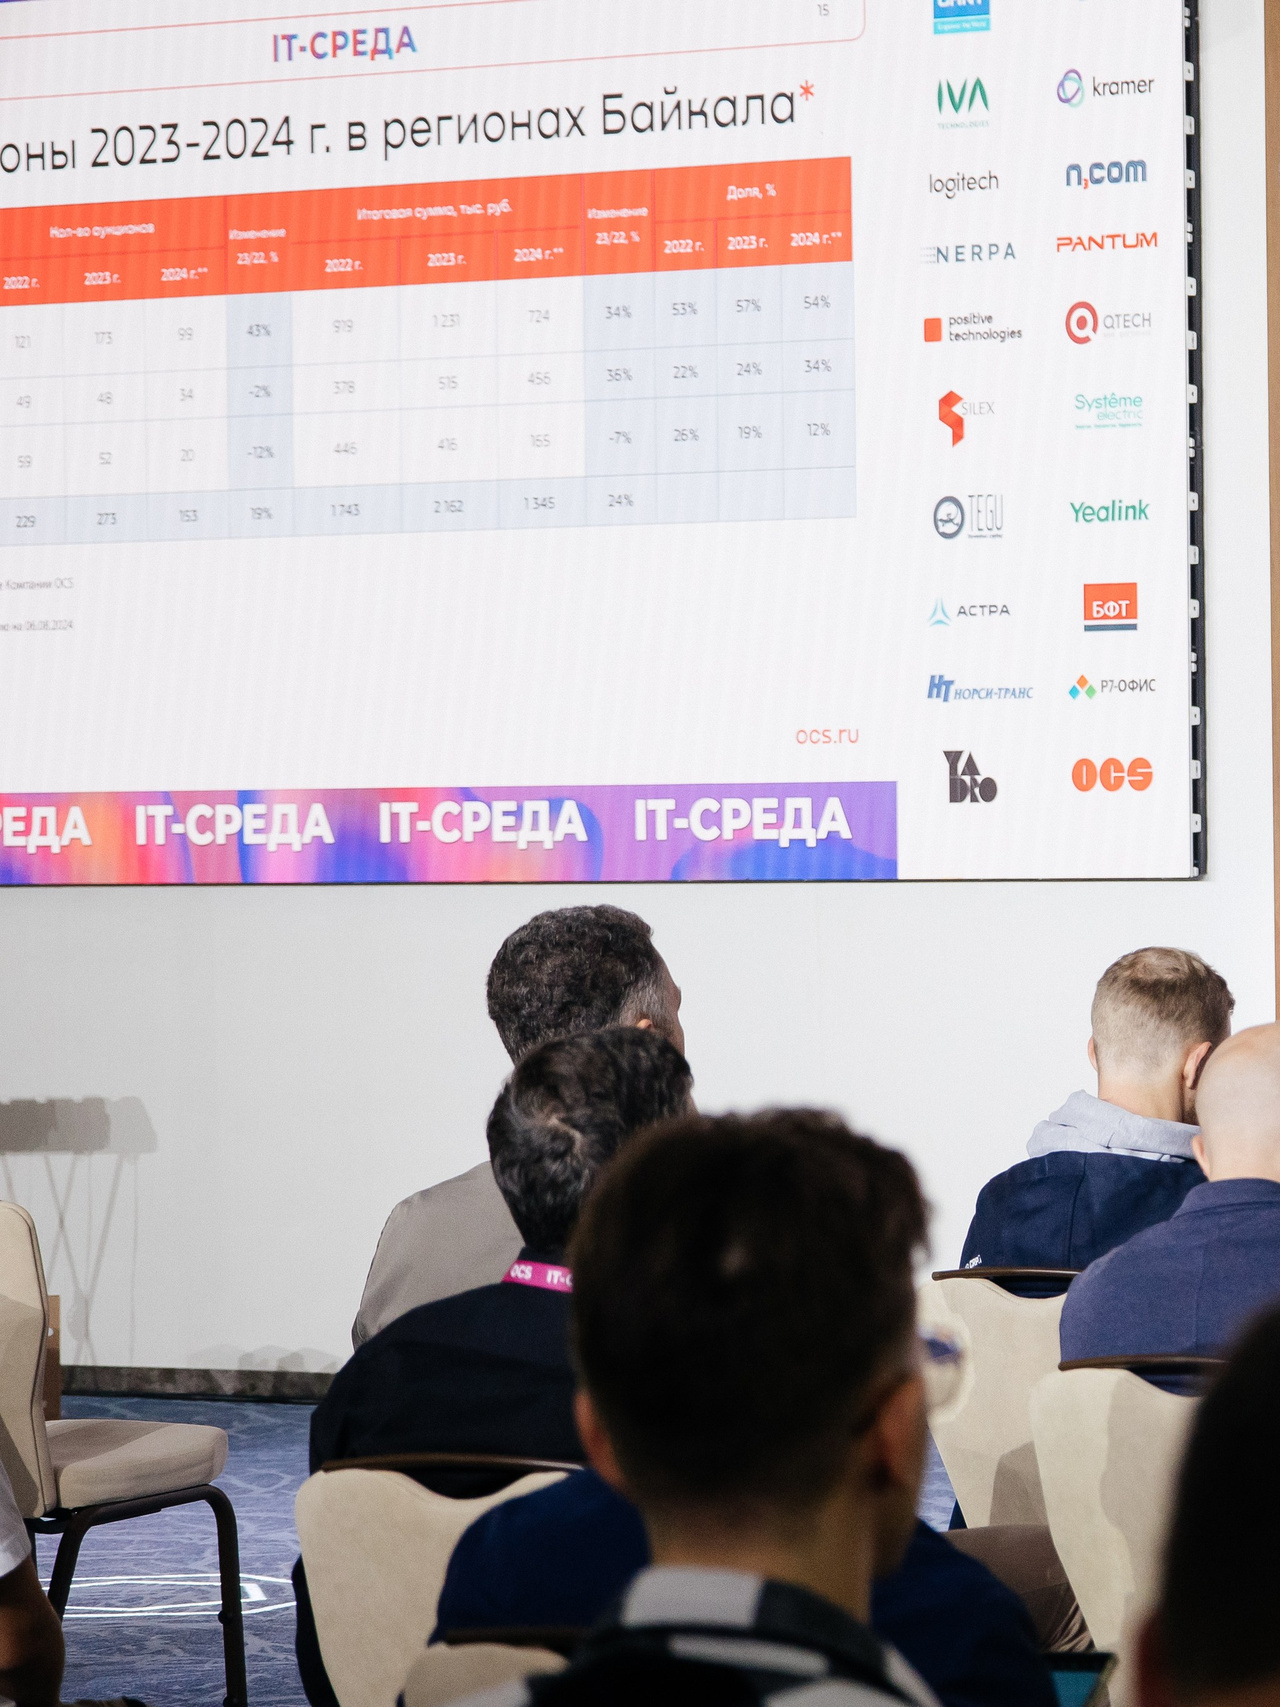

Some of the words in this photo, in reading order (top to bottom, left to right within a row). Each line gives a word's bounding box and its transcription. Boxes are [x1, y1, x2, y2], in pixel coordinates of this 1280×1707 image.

[817, 3, 830, 17] 15
[273, 25, 418, 63] IT-СРЕДА
[1092, 76, 1155, 97] kramer
[91, 115, 294, 168] 2023-2024
[310, 123, 331, 154] г.
[348, 120, 367, 152] в
[384, 103, 586, 162] регионах
[929, 170, 999, 200] logitech
[727, 184, 763, 202] Доля,
[765, 183, 777, 197] %
[727, 236, 756, 250] 2023
[790, 232, 820, 246] 2024
[1057, 232, 1158, 252] PANTUM
[664, 240, 692, 254] 2022
[937, 242, 1016, 264] NERPA
[672, 302, 698, 316] 53%
[736, 299, 762, 312] 57%
[804, 295, 831, 309] 54%
[605, 305, 632, 319] 34%
[949, 313, 993, 327] positive
[1103, 312, 1151, 329] QTECH
[949, 327, 1023, 343] technologies
[673, 365, 699, 379] 22%
[737, 362, 762, 376] 24%
[804, 359, 832, 373] 34%
[961, 401, 995, 416] SILEX
[1075, 392, 1143, 412] Système
[1097, 409, 1143, 421] electric
[674, 428, 700, 442] 26%
[738, 426, 762, 439] 19%
[807, 423, 831, 437] 12%
[608, 431, 632, 444] -7%
[608, 493, 634, 507] 24%
[968, 494, 1003, 532] TEGU
[1070, 500, 1150, 523] Yealink
[957, 604, 1011, 617] АСТРА
[1092, 600, 1130, 618] БФТ
[1101, 678, 1156, 694] Р7-ОФИС
[954, 687, 1034, 701] НОРСИ-ТРАНС
[796, 727, 860, 745] ocs.ru
[1072, 757, 1153, 792] OCS
[0, 804, 92, 855] ЕДА
[135, 802, 335, 853] IT-СРЕДА
[379, 798, 589, 850] IT-СРЕДА
[634, 796, 853, 848] IT-СРЕДА
[510, 1265, 532, 1280] OCS
